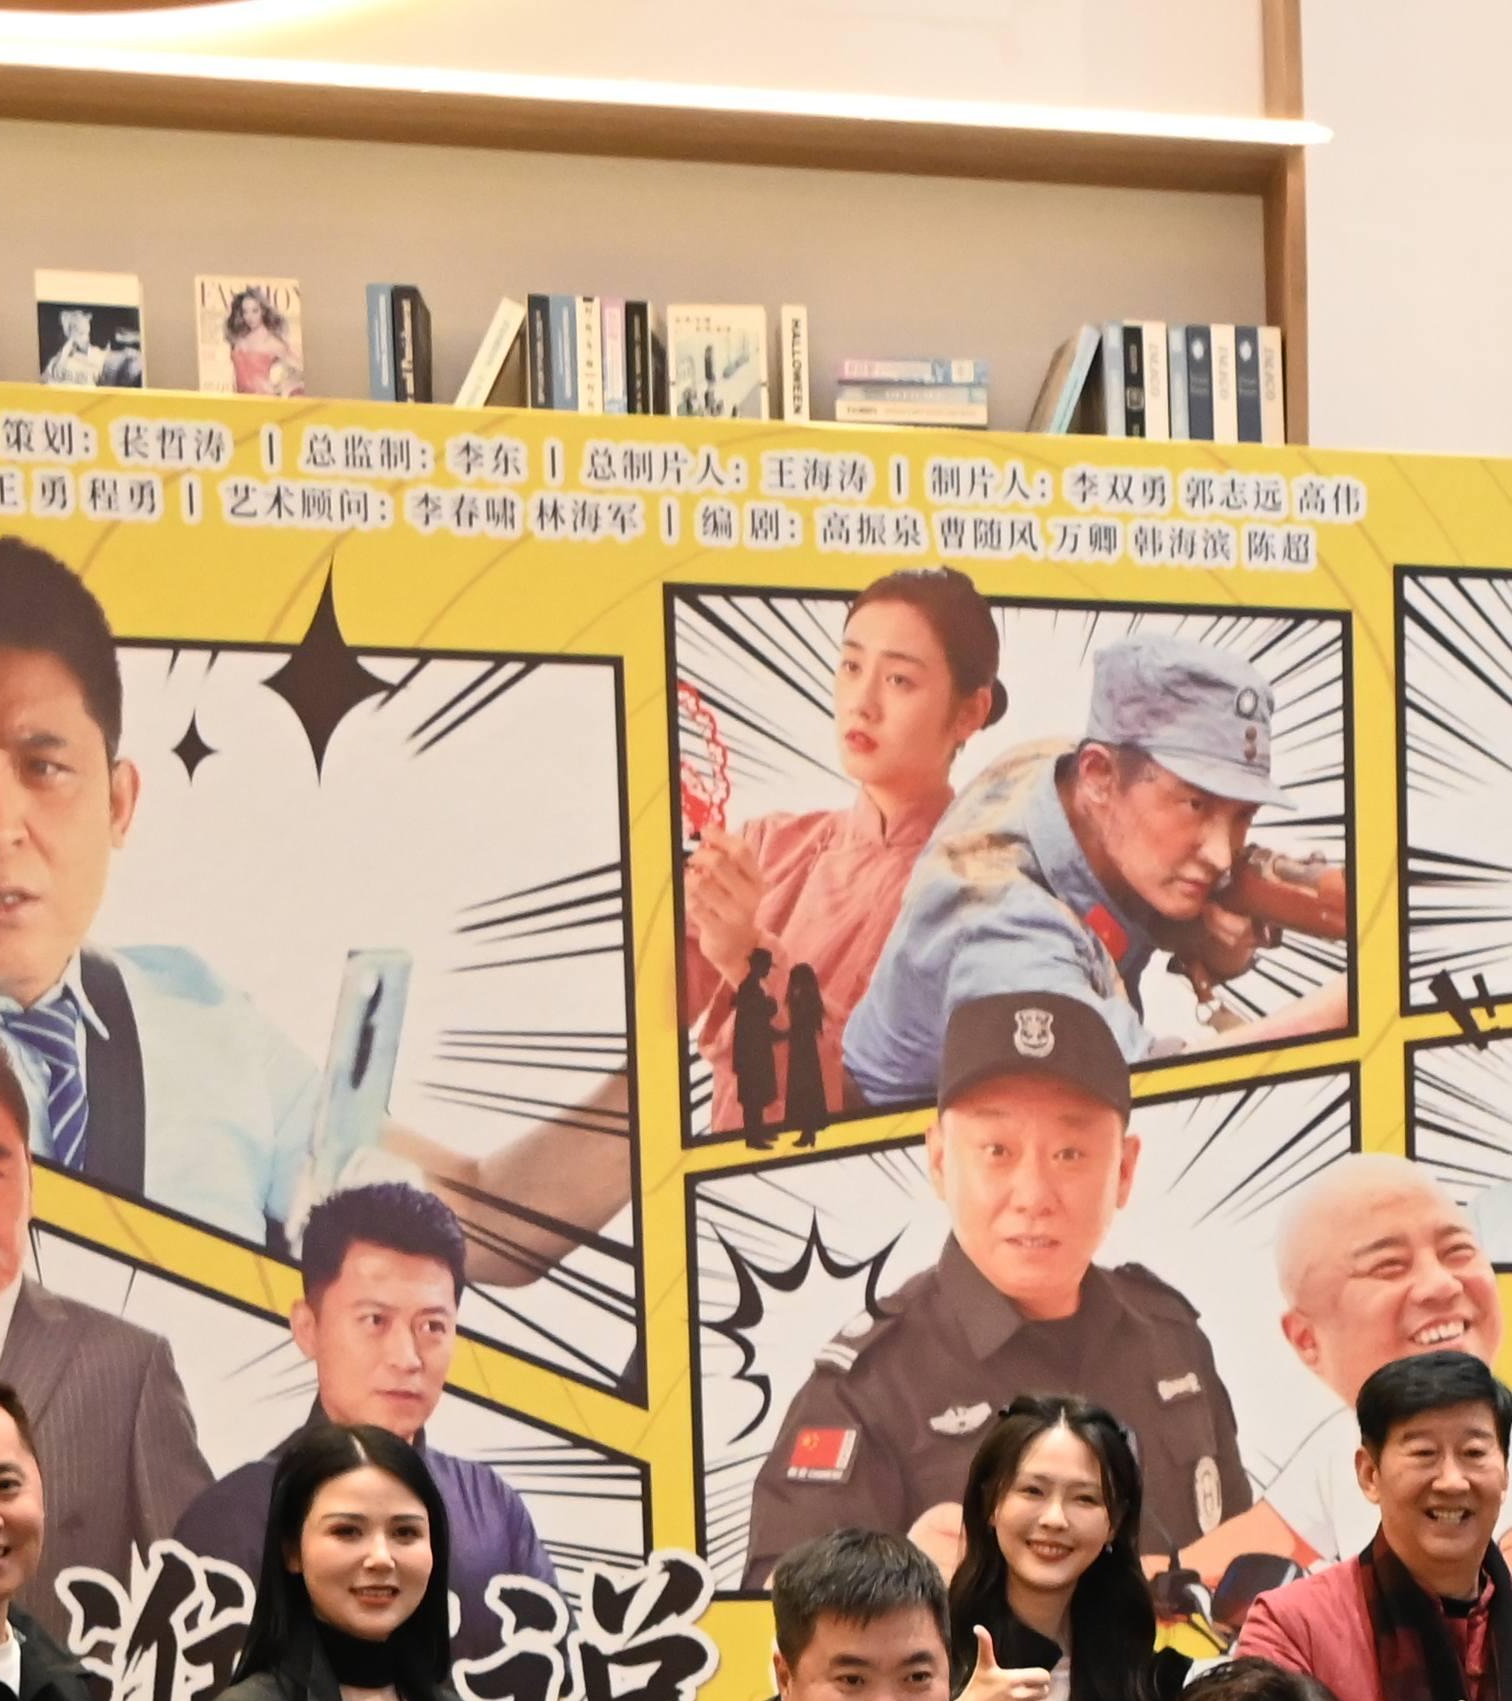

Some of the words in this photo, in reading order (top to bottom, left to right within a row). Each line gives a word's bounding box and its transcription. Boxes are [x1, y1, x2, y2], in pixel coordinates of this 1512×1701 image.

[791, 318, 803, 414] HALLOWEEN
[2, 417, 90, 457] 策划：
[305, 433, 427, 472] 总监制：
[452, 440, 521, 477] 李东
[586, 447, 741, 486] 总制片人：
[767, 454, 867, 494] 王海涛
[931, 463, 1046, 500] 制片人：
[1070, 469, 1167, 508] 李双勇
[1185, 476, 1282, 513] 郭志远
[1299, 481, 1360, 516] 高伟
[88, 477, 156, 515] 程勇
[229, 483, 387, 524] 艺术顾问：
[536, 497, 637, 535] 林海军
[940, 516, 1039, 553] 曹随风
[1247, 530, 1310, 565] 陈超
